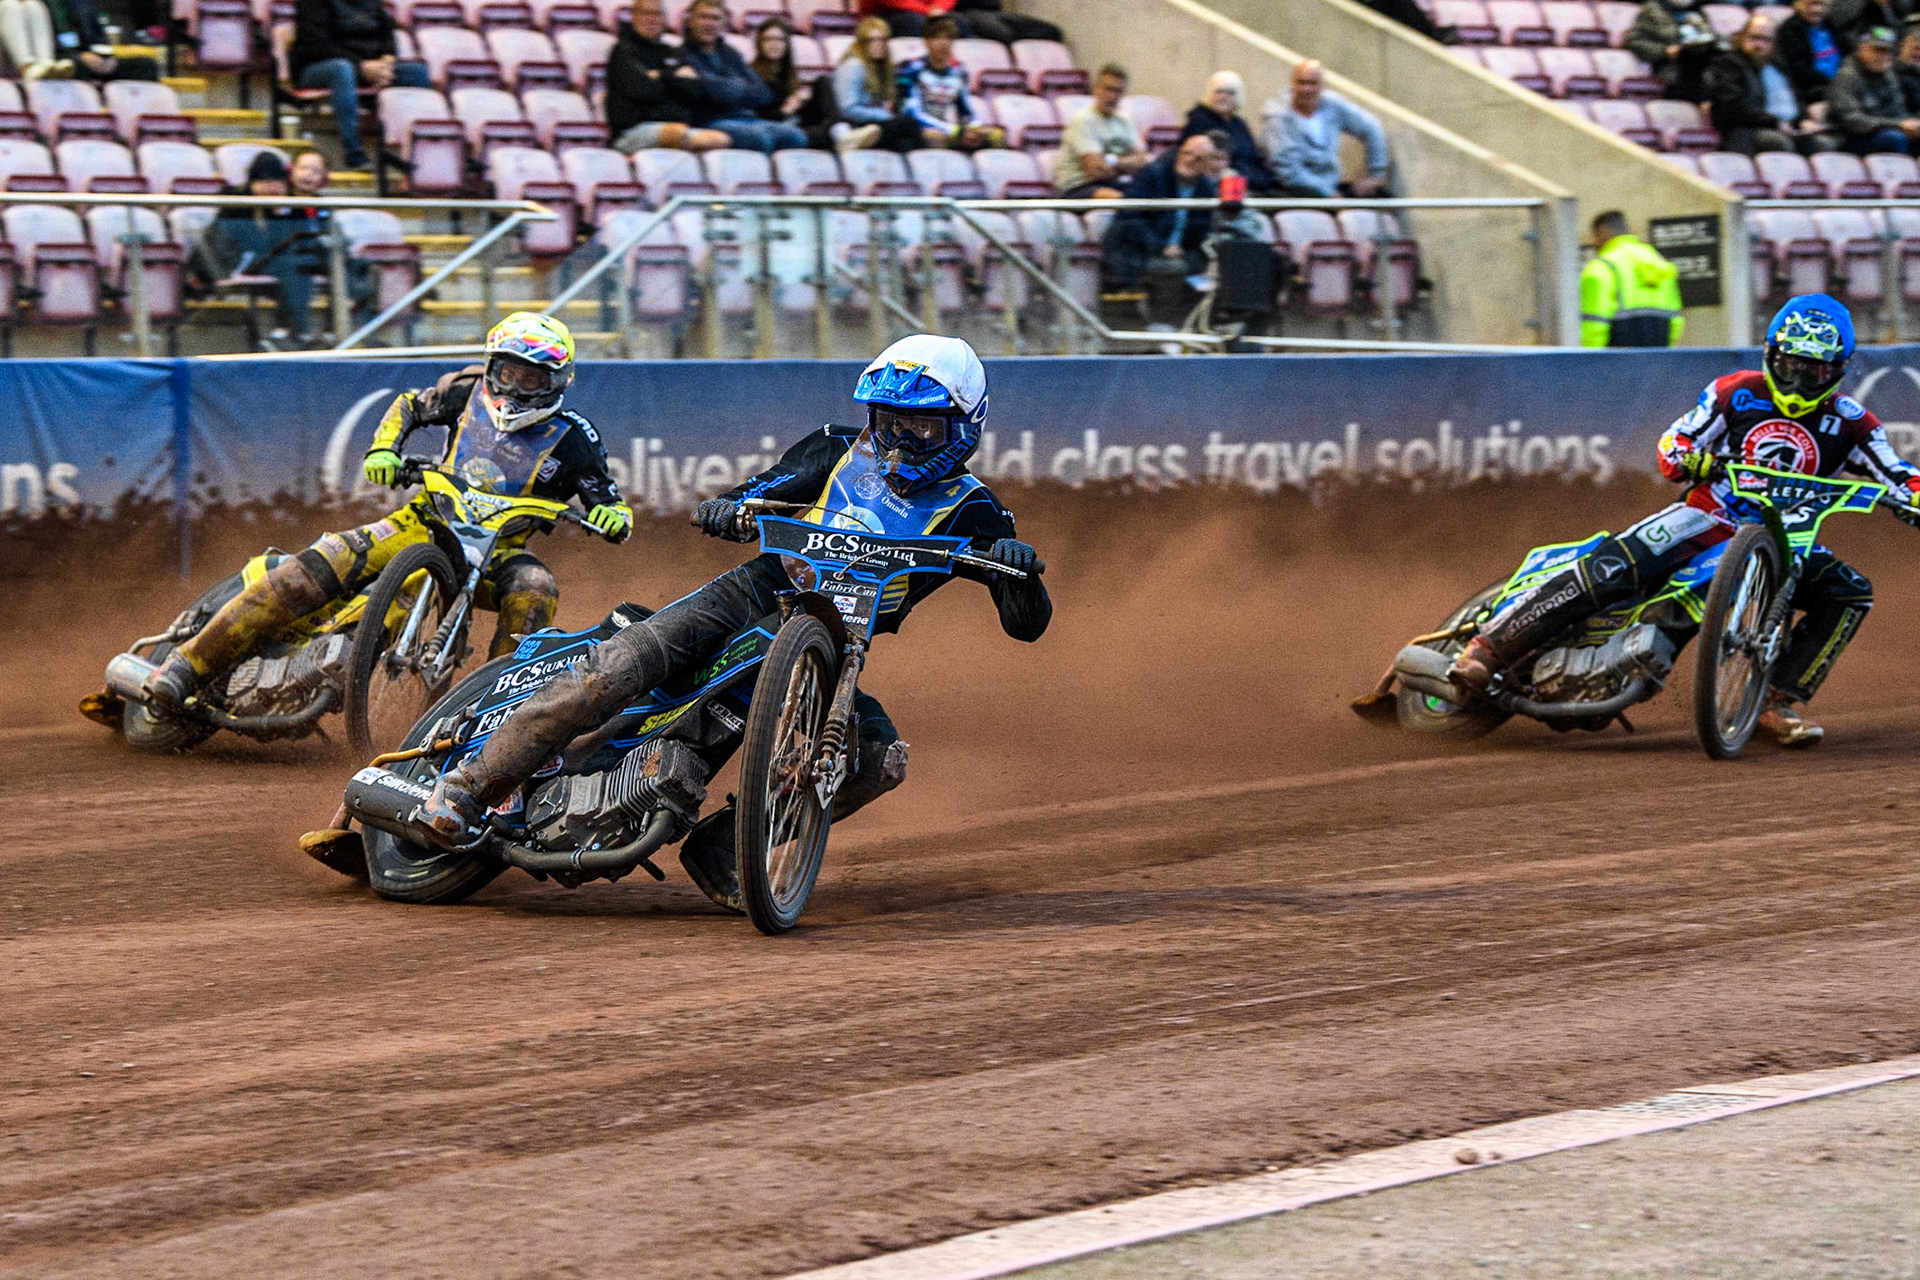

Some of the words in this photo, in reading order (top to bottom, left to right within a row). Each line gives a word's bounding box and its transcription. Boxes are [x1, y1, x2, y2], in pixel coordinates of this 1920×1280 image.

[1052, 428, 1188, 488] class
[1205, 423, 1360, 493] travel
[1375, 420, 1615, 486] solutions
[881, 496, 909, 519] Omada
[806, 533, 860, 553] BCS
[893, 550, 914, 562] Ltd
[492, 661, 544, 695] BCS
[542, 656, 571, 675] (UK)
